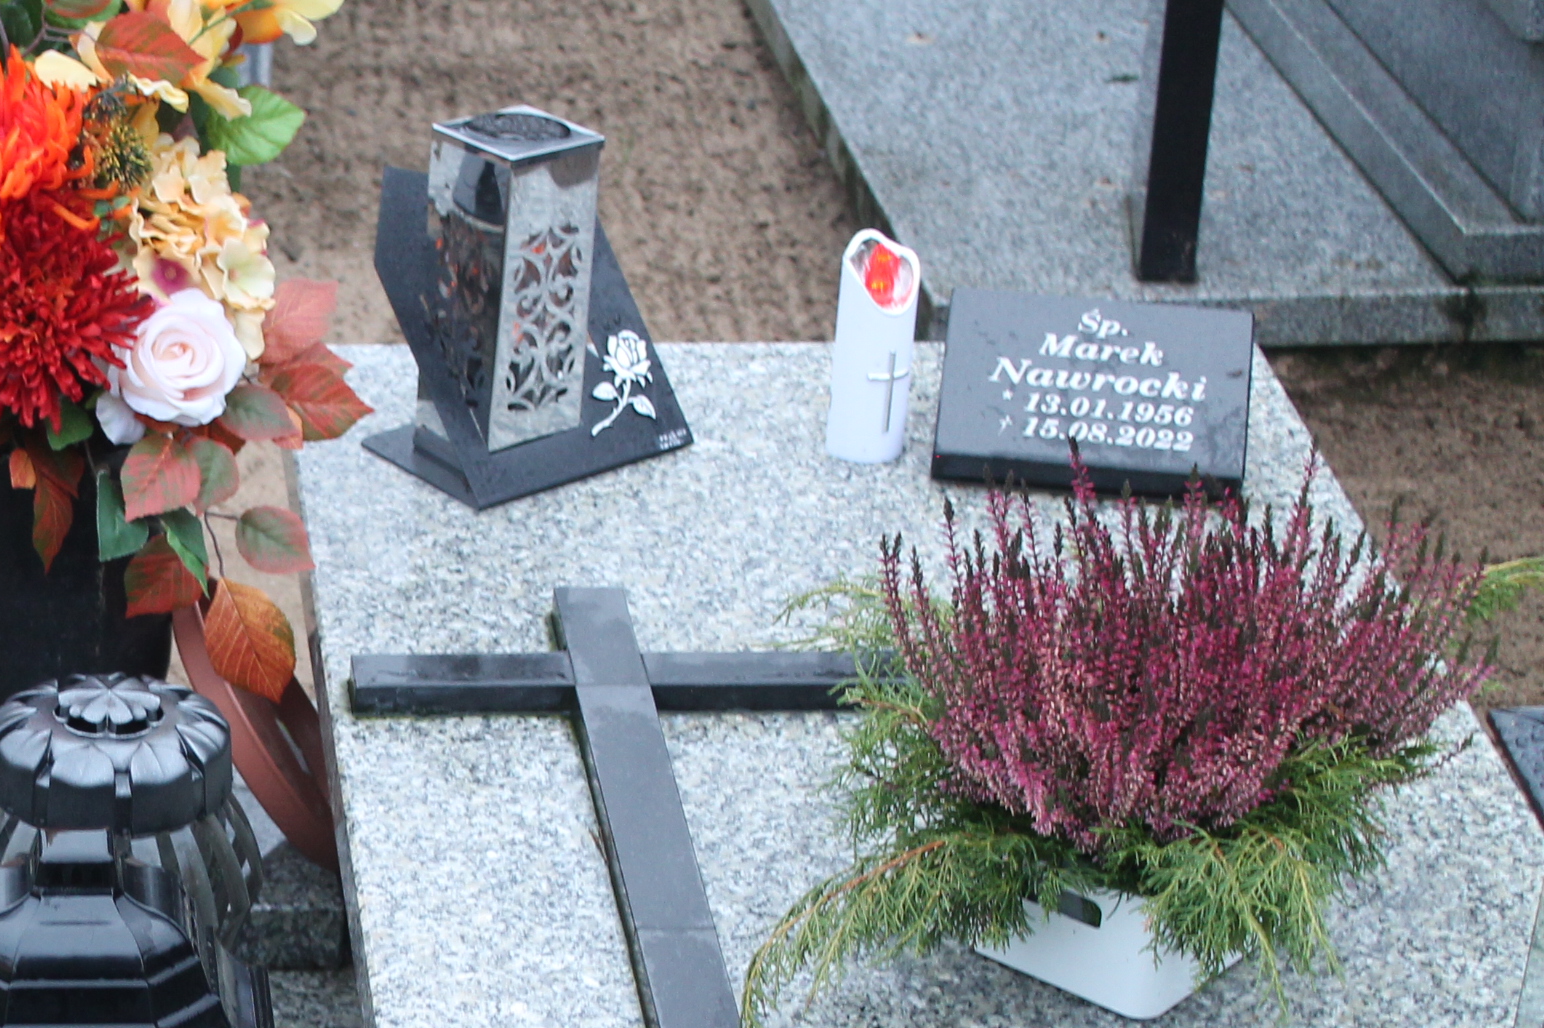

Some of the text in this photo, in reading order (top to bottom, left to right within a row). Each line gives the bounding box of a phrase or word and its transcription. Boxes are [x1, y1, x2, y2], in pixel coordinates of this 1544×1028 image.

[1077, 308, 1129, 339] Śp.
[1038, 331, 1165, 367] Marek
[987, 355, 1208, 403] Nawrocki
[1023, 391, 1194, 428] 13.01.1956
[1022, 415, 1194, 453] 15.08.2022
